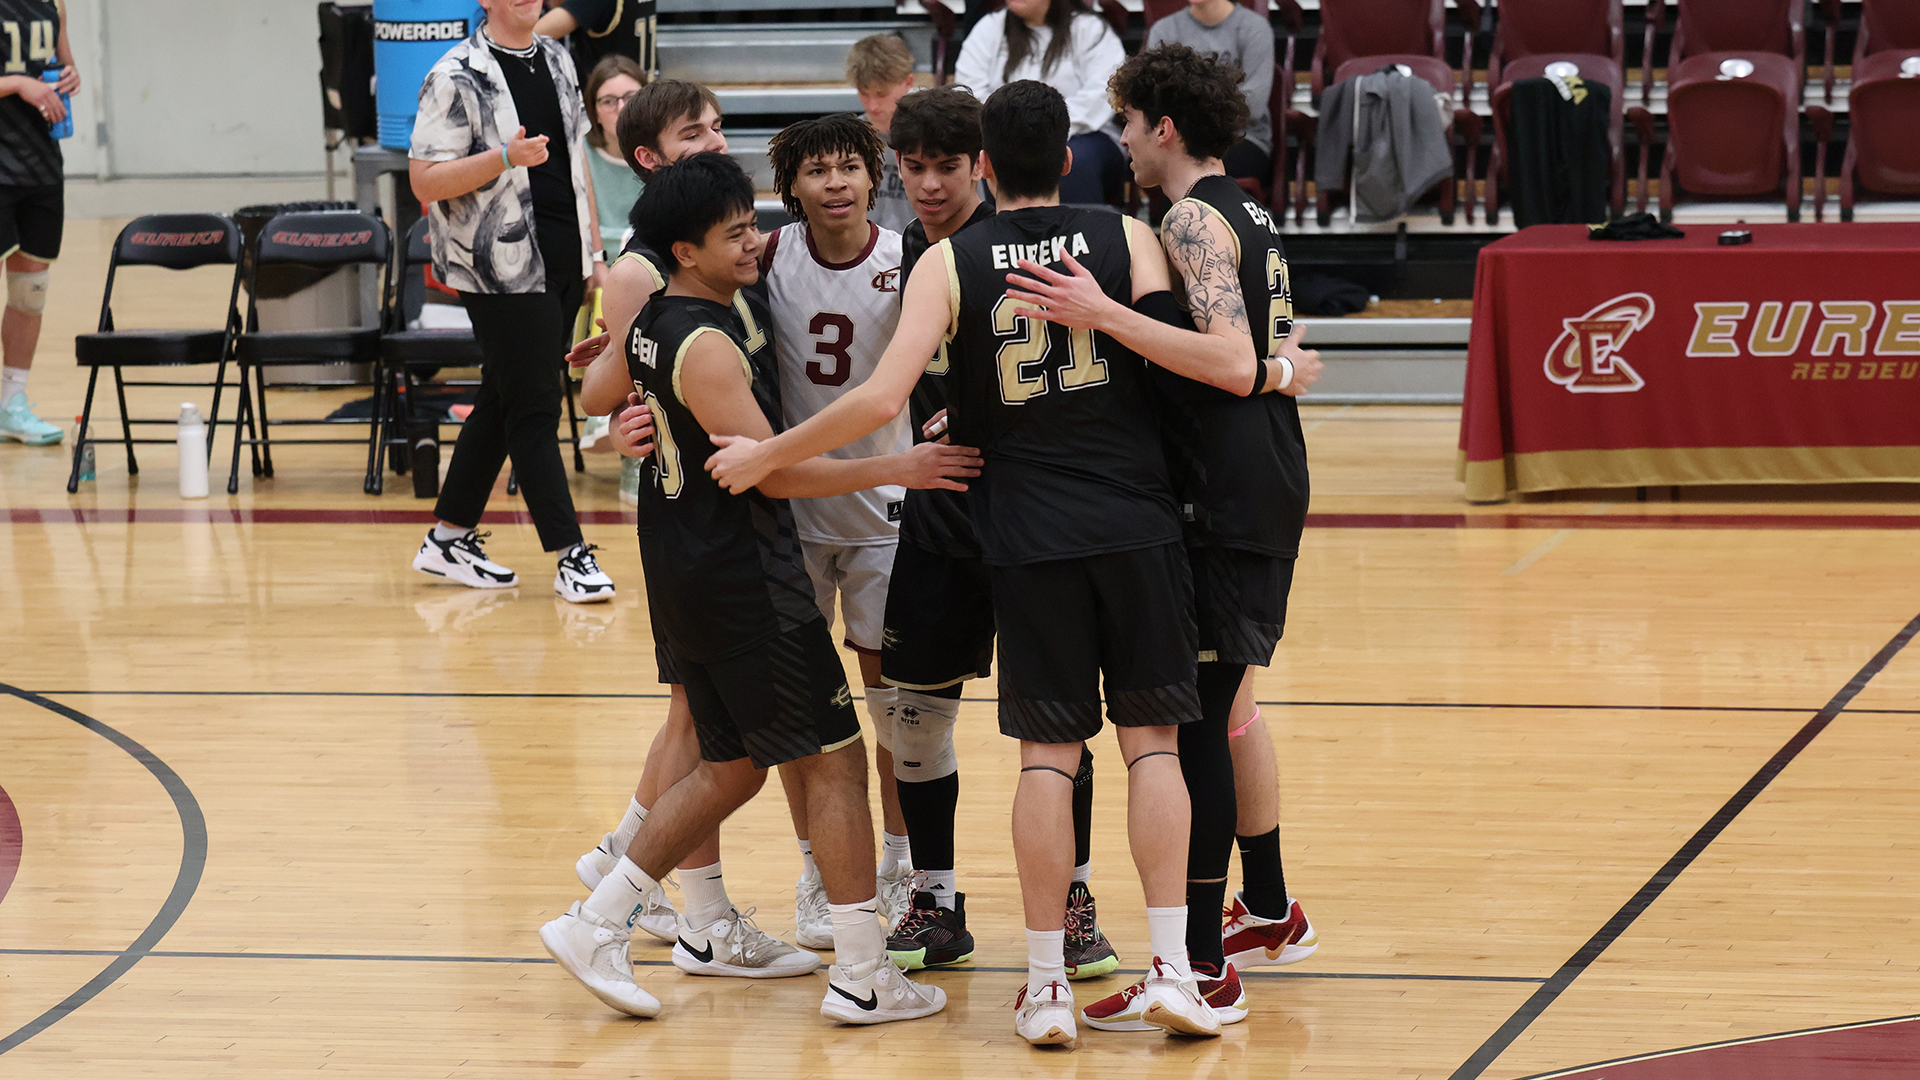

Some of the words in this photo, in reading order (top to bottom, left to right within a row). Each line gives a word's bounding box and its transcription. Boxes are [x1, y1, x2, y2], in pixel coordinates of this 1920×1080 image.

[3, 20, 56, 73] 14
[374, 21, 465, 41] POWERADE
[991, 232, 1090, 270] EUREKA
[805, 310, 856, 389] 3
[991, 293, 1110, 405] 21
[1791, 361, 1852, 381] RED
